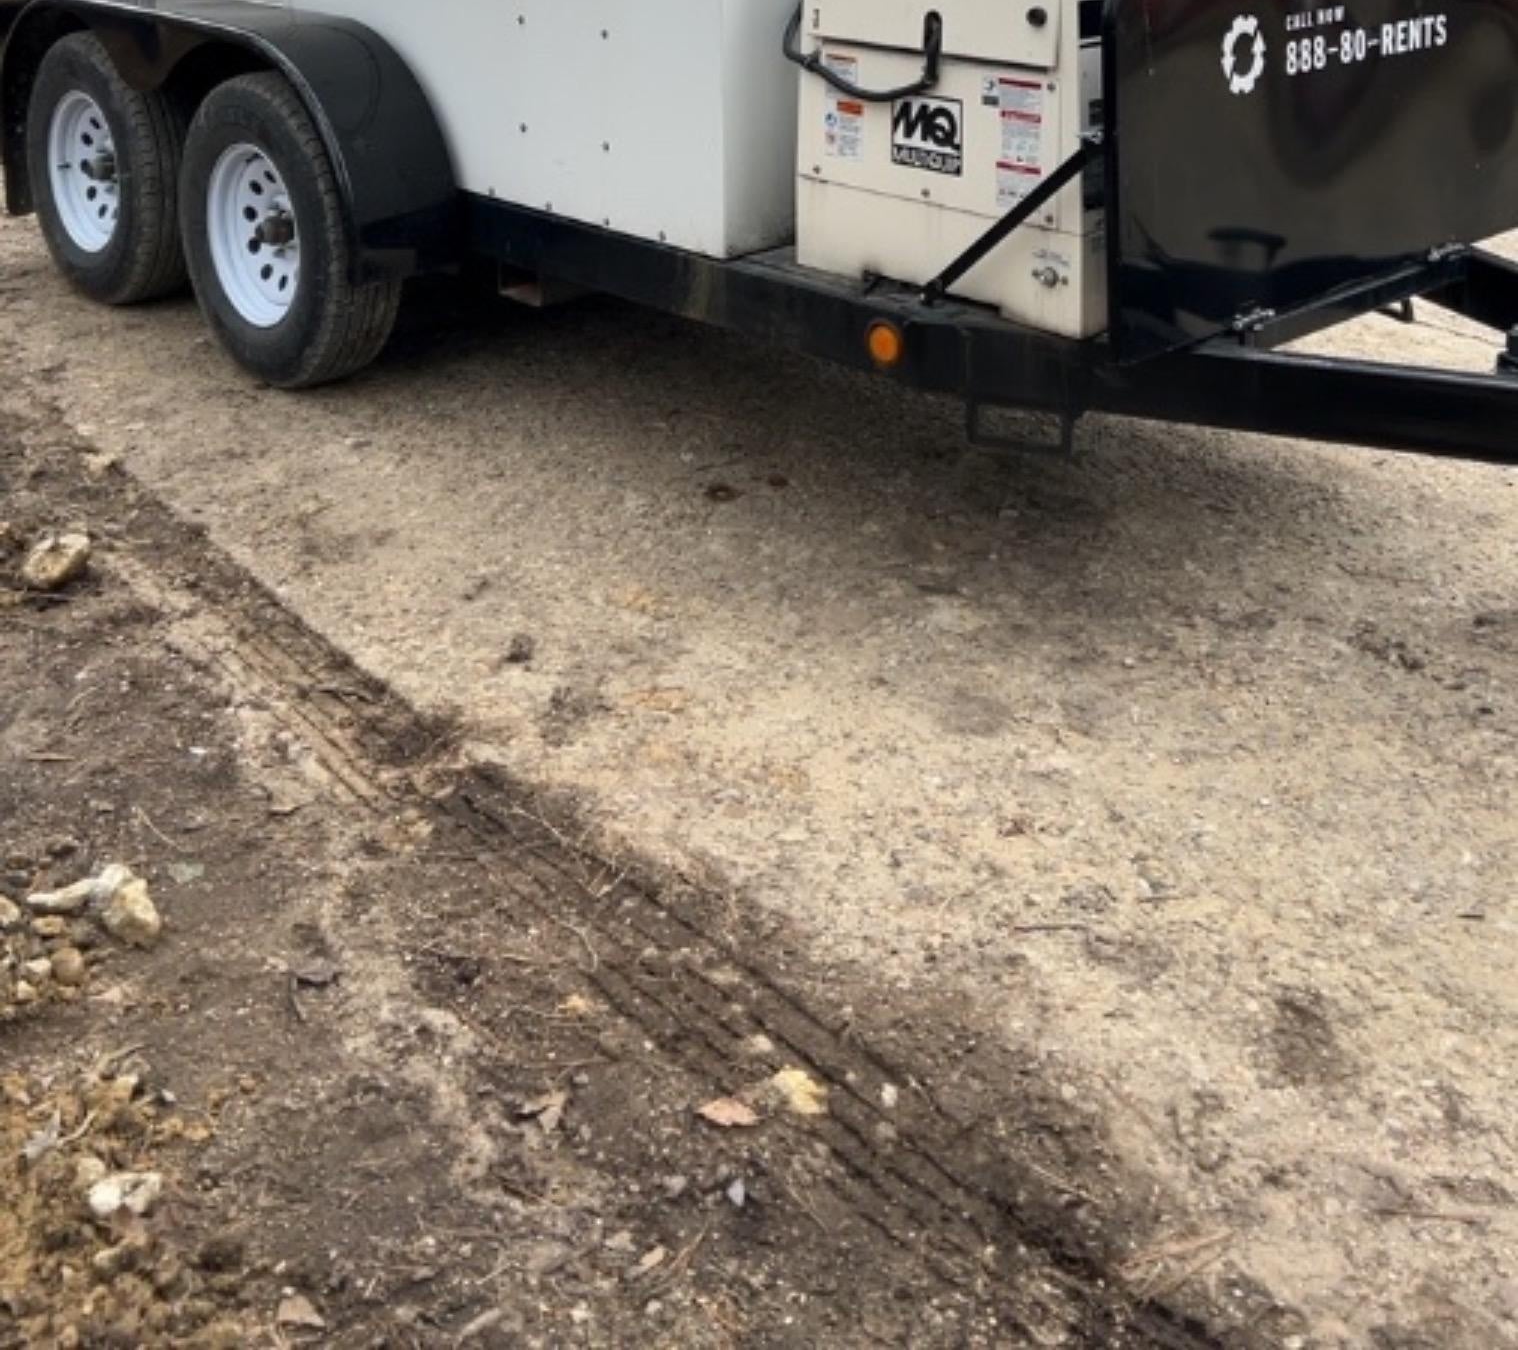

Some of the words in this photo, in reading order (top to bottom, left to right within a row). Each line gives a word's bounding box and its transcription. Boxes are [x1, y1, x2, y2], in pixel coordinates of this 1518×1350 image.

[1286, 11, 1314, 31] CALL
[1316, 5, 1346, 26] NOW
[1286, 14, 1448, 76] 888-80-RENTS
[893, 100, 961, 150] MQ
